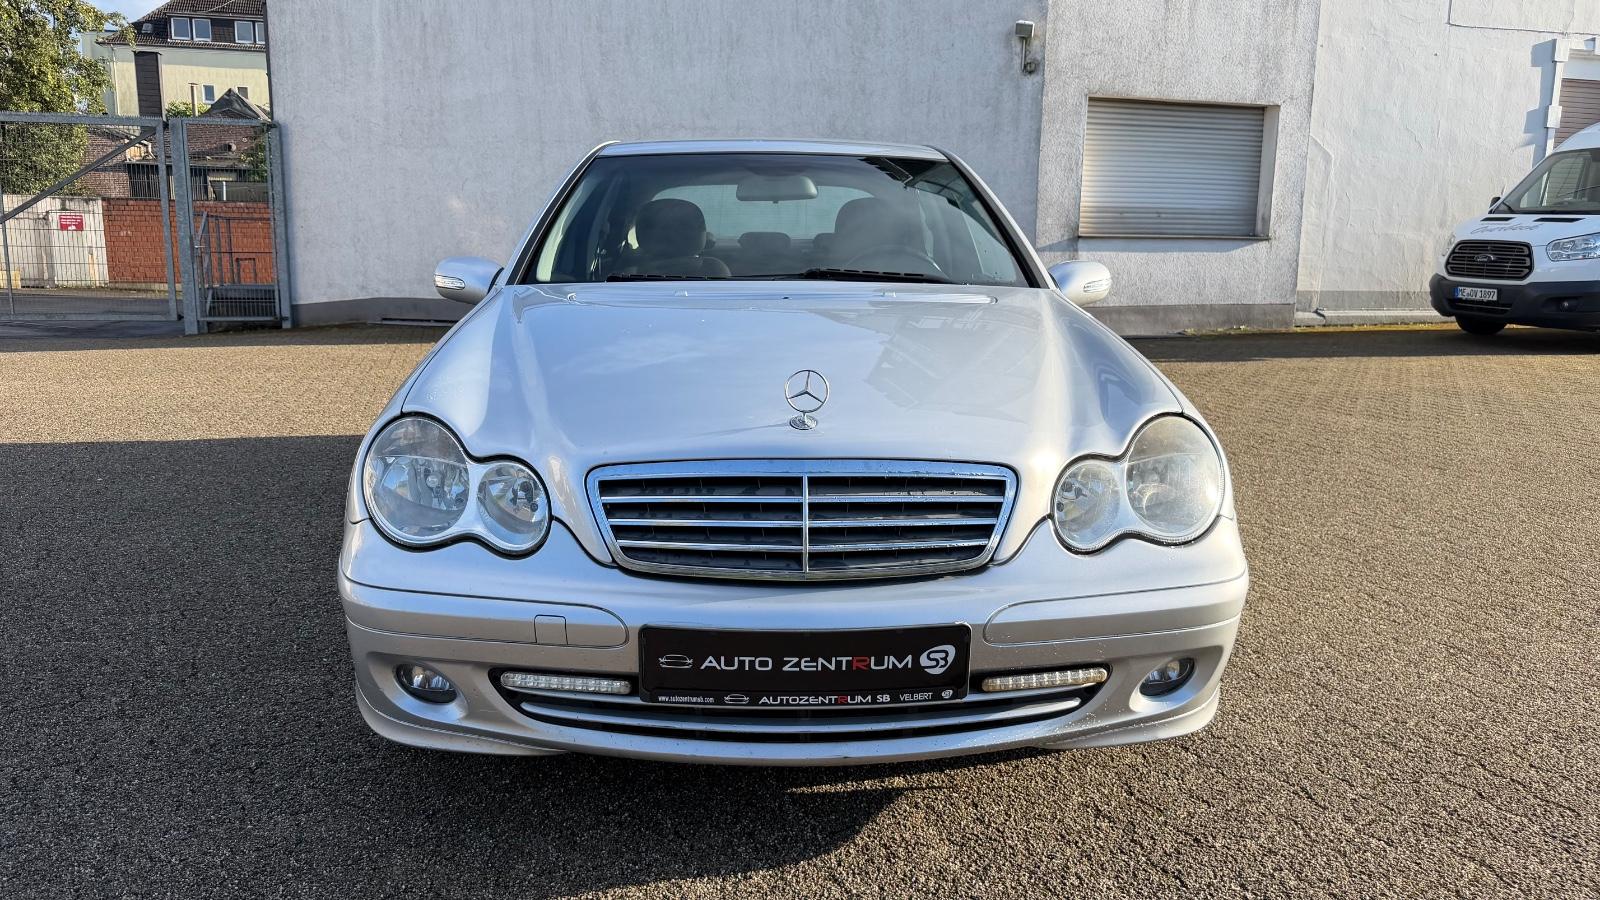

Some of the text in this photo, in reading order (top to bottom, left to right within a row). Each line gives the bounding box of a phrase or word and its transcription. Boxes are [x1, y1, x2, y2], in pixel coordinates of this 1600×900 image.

[1479, 289, 1496, 299] 1897
[700, 654, 912, 671] AUTO ZENTRUM
[920, 648, 951, 670] SB
[759, 692, 934, 704] AUTOZENTRUM SB VELBERT
